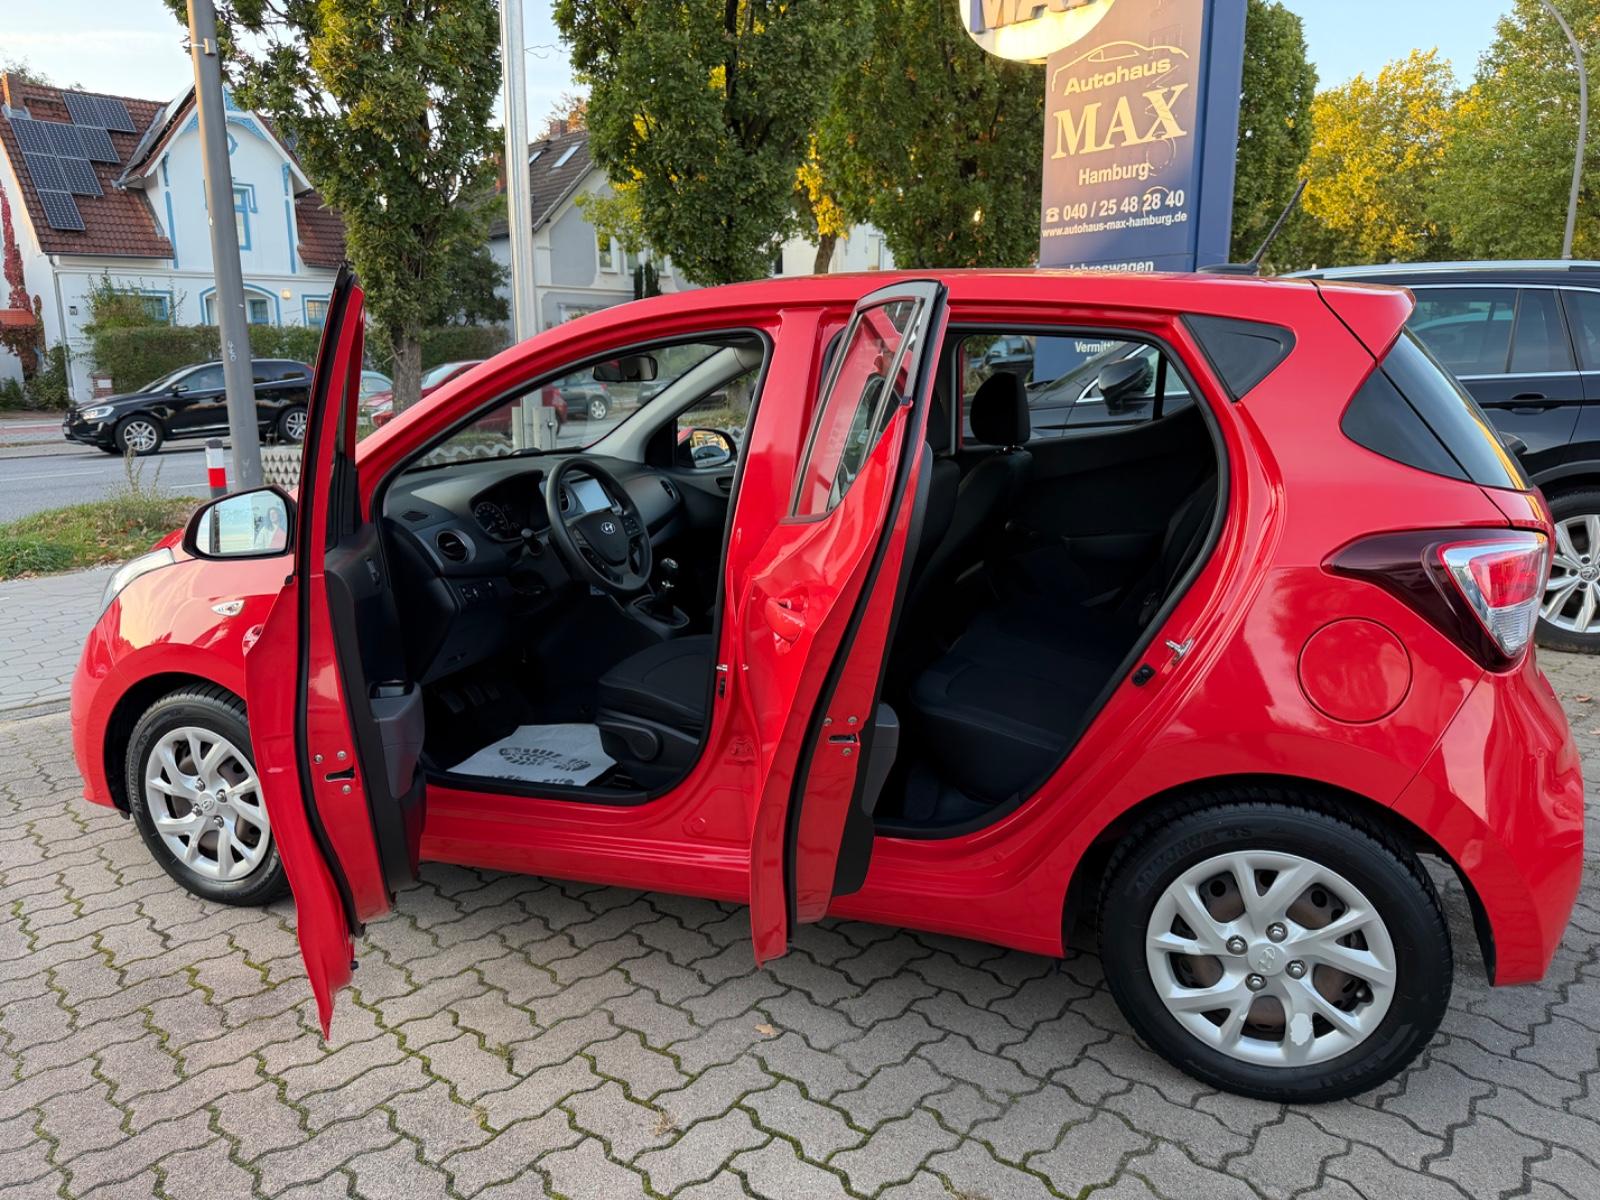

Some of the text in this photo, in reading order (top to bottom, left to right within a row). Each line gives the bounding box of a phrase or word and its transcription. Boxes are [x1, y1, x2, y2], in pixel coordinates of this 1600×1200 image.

[1063, 58, 1171, 96] Autohaus
[1051, 83, 1189, 159] MAX
[1078, 162, 1150, 186] Hamburg
[1063, 189, 1185, 221] 040 / 25 48 28 40
[1041, 212, 1188, 237] www.autohaus-max-hamburg.de
